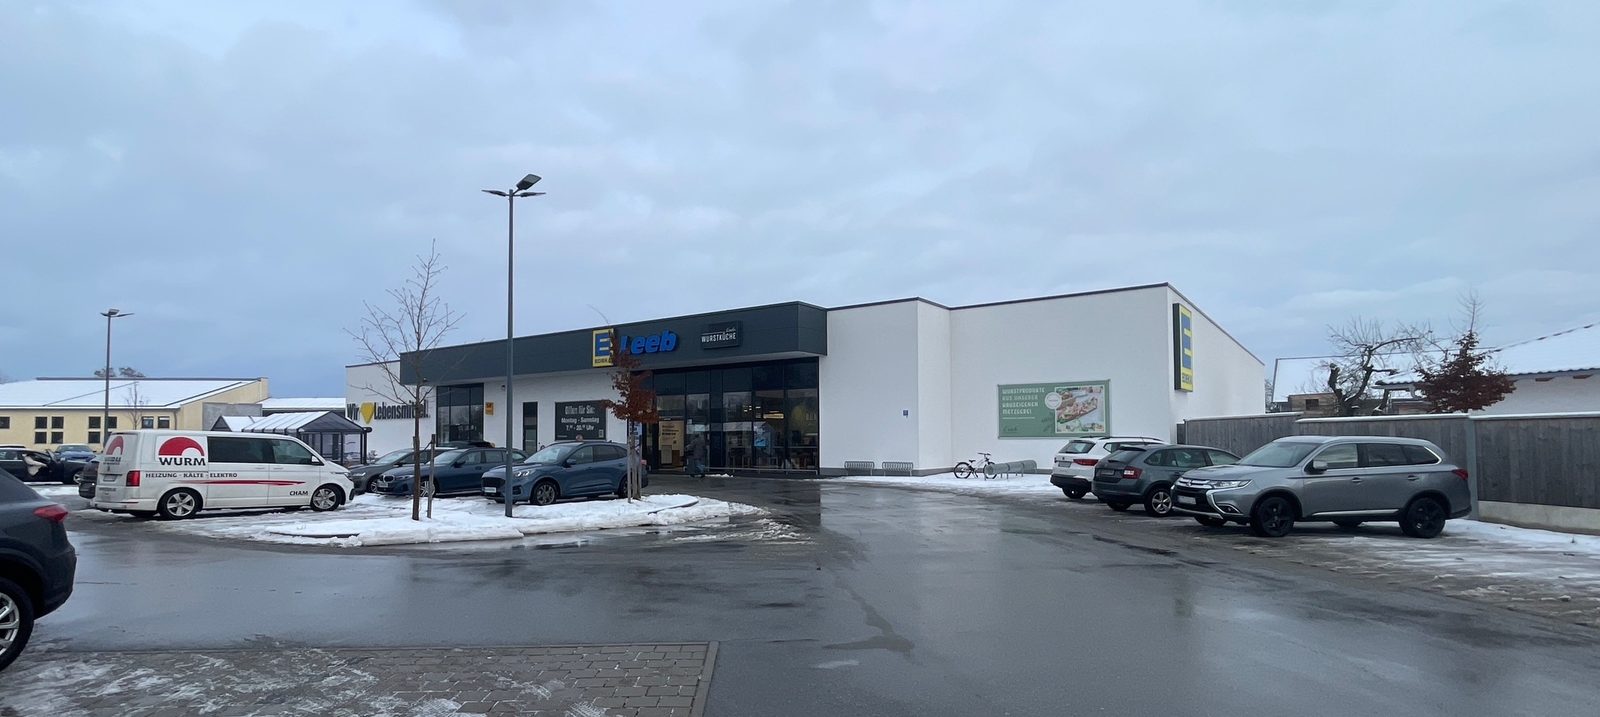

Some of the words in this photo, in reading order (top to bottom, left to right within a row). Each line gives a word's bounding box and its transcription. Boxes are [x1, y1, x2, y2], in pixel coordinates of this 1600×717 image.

[346, 403, 360, 420] Wir
[373, 399, 429, 420] Lebensmitel.
[159, 457, 206, 466] WURM
